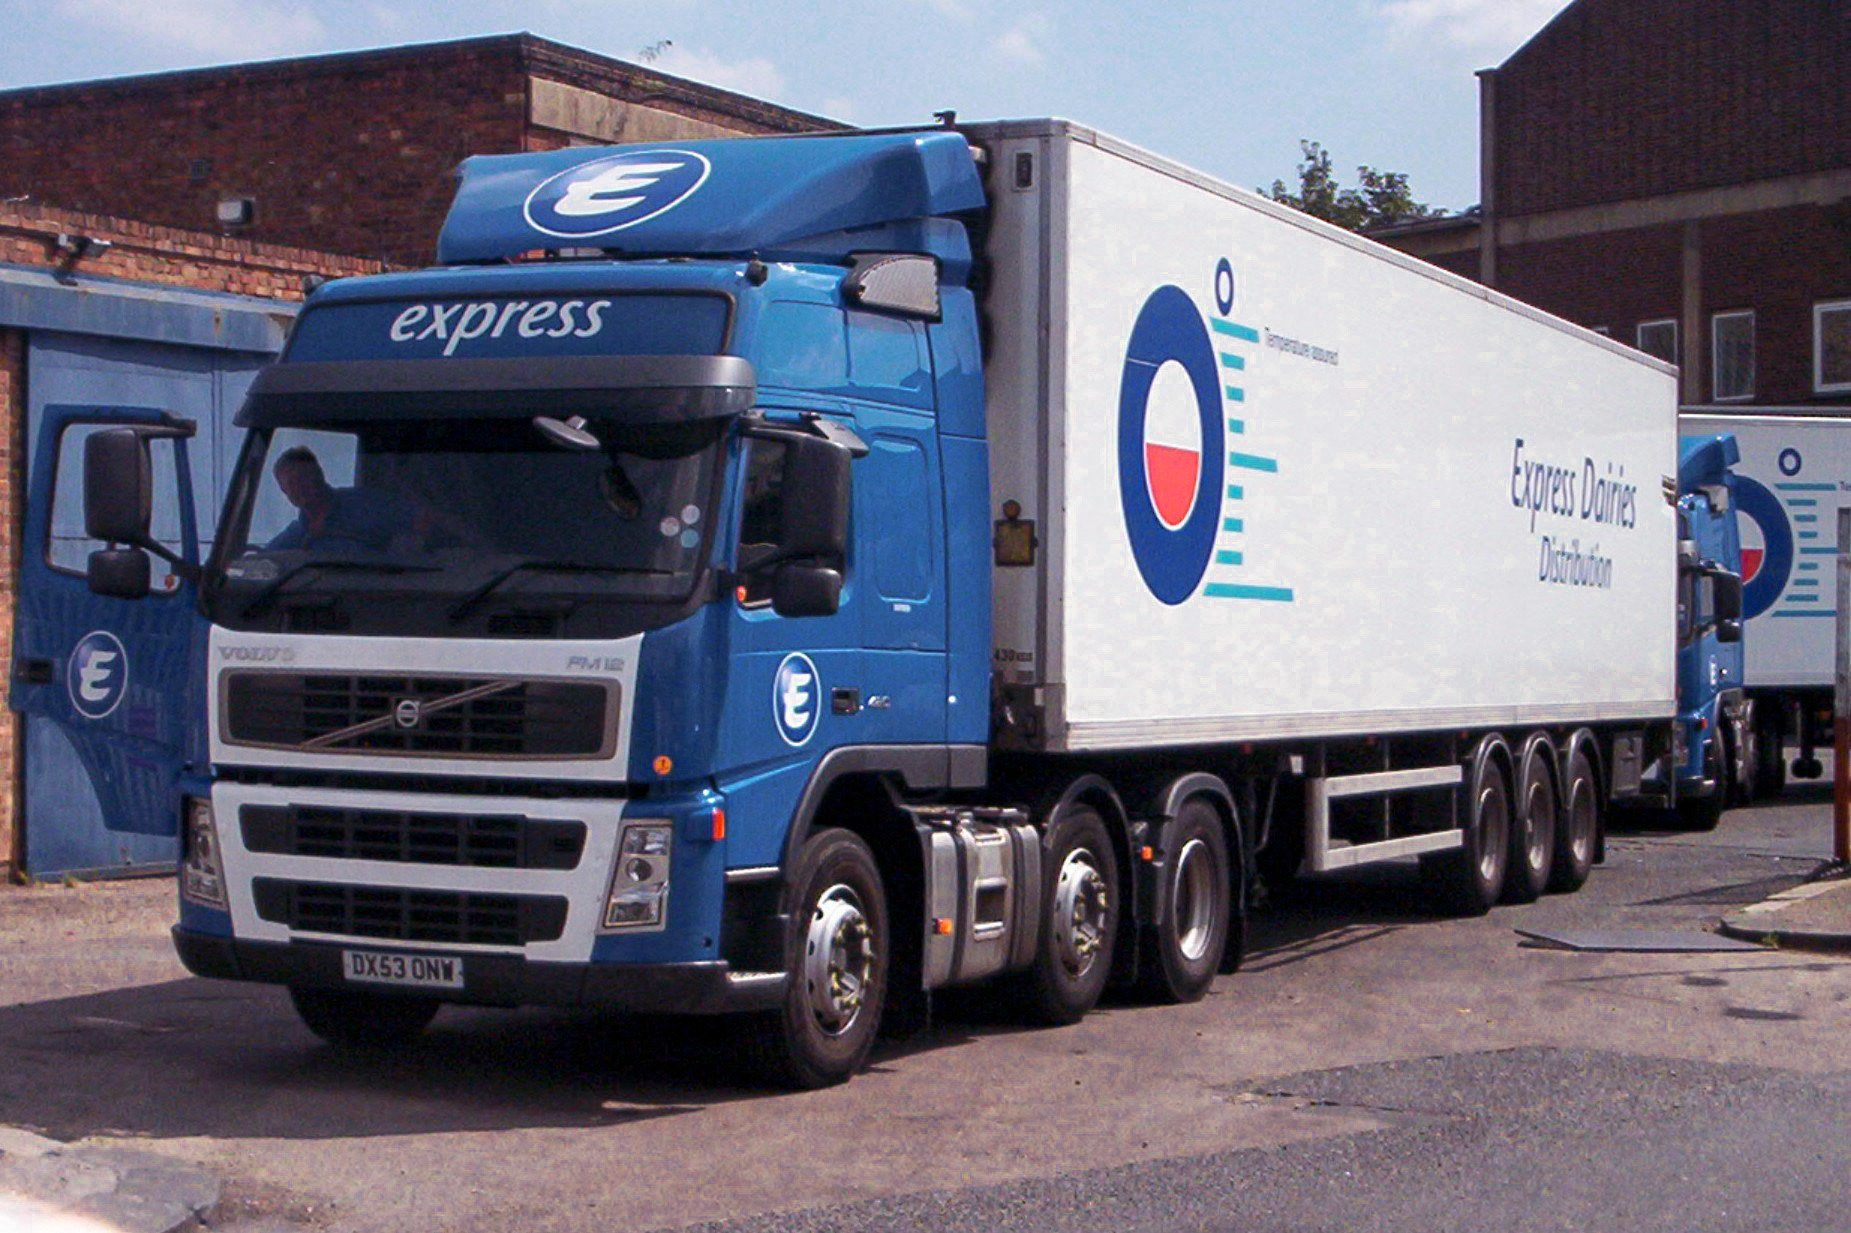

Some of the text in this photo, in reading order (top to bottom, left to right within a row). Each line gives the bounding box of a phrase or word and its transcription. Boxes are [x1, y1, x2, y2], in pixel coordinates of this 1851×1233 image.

[553, 162, 686, 217] E
[390, 299, 612, 357] express
[1511, 438, 1637, 533] Express Dairies
[1539, 536, 1613, 588] Distribution
[79, 650, 117, 702] E
[216, 646, 296, 662] VOLVO
[782, 673, 812, 729] E
[351, 953, 454, 982] DX53 ONW
